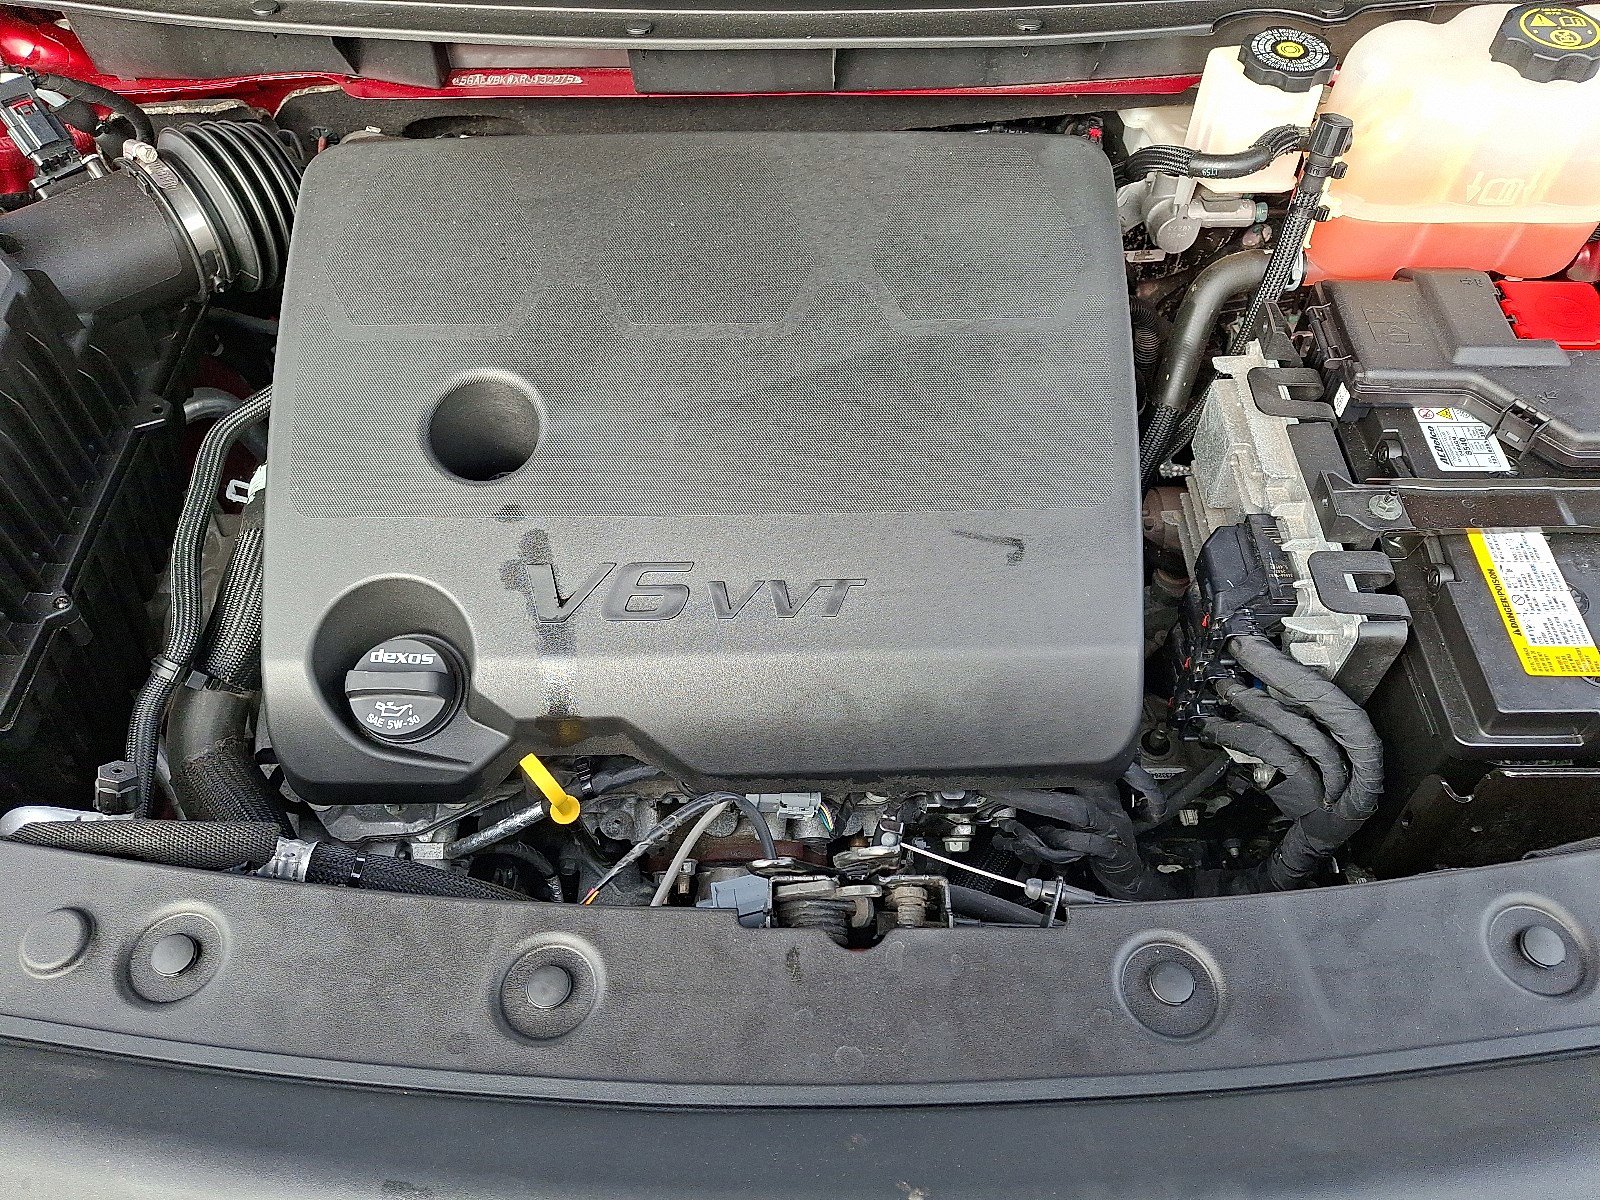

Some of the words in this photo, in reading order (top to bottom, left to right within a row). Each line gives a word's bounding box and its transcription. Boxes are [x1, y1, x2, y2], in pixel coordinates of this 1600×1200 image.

[1427, 425, 1450, 465] ACDelco
[526, 561, 695, 623] V6
[707, 578, 867, 620] VVT
[369, 648, 437, 665] dexos
[366, 713, 385, 728] SAE
[387, 714, 420, 730] 5W-30
